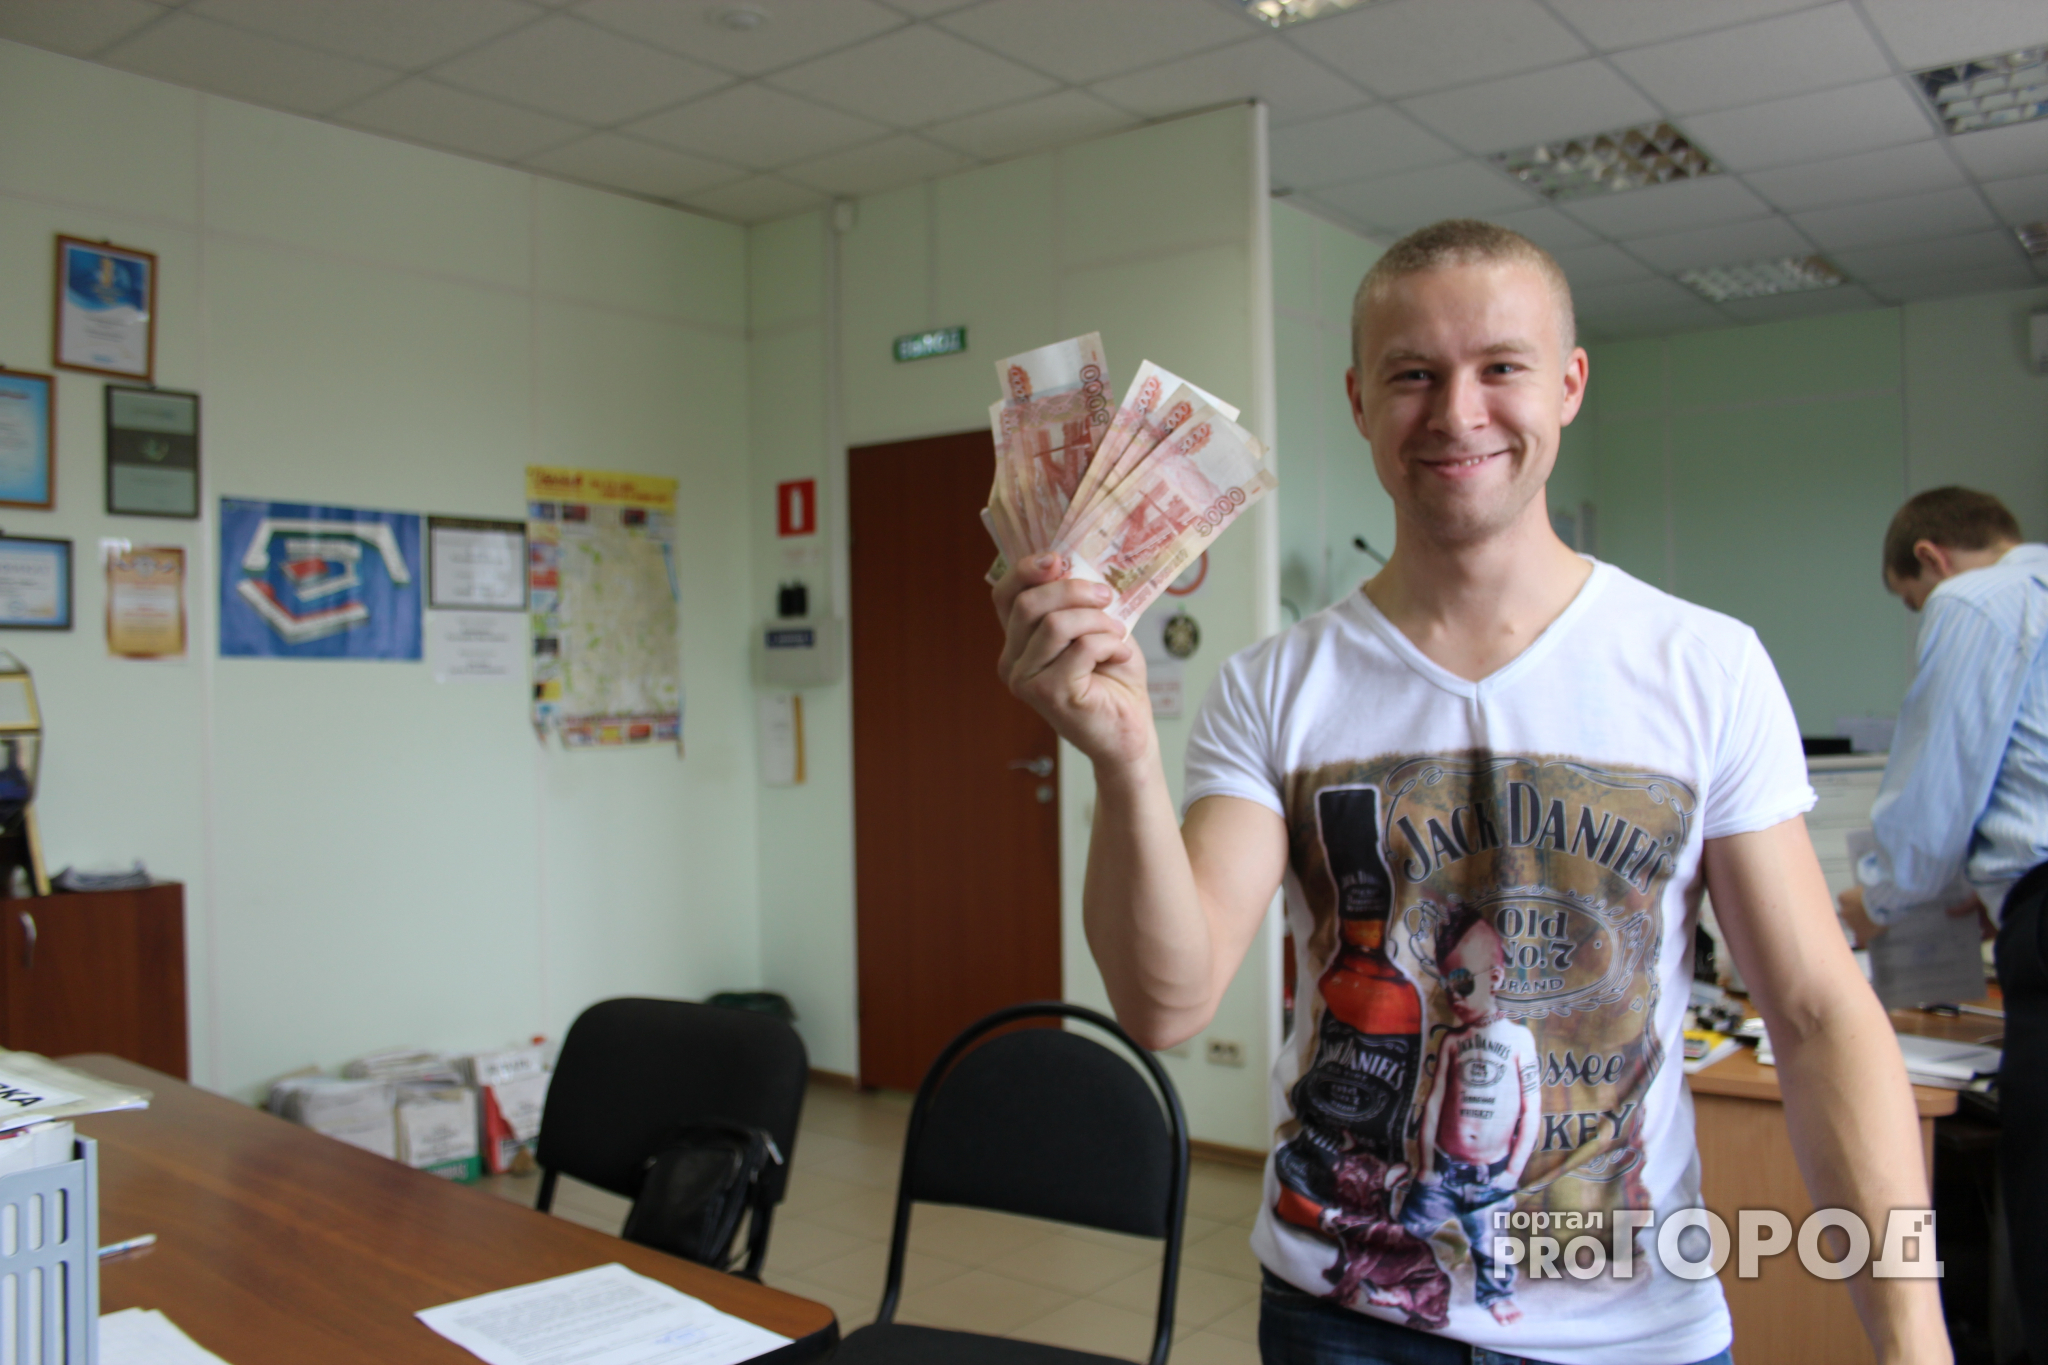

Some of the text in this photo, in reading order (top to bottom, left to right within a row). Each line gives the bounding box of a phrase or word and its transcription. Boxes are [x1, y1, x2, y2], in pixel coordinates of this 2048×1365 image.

[1079, 364, 1110, 427] 5000
[1135, 378, 1160, 415] 5000
[1162, 401, 1191, 434] 5000
[1178, 423, 1210, 455] 5000
[1193, 486, 1246, 538] 5000
[1396, 781, 1676, 895] JACK DANIEL'S
[1496, 906, 1570, 941] Old
[1500, 976, 1566, 995] RAND
